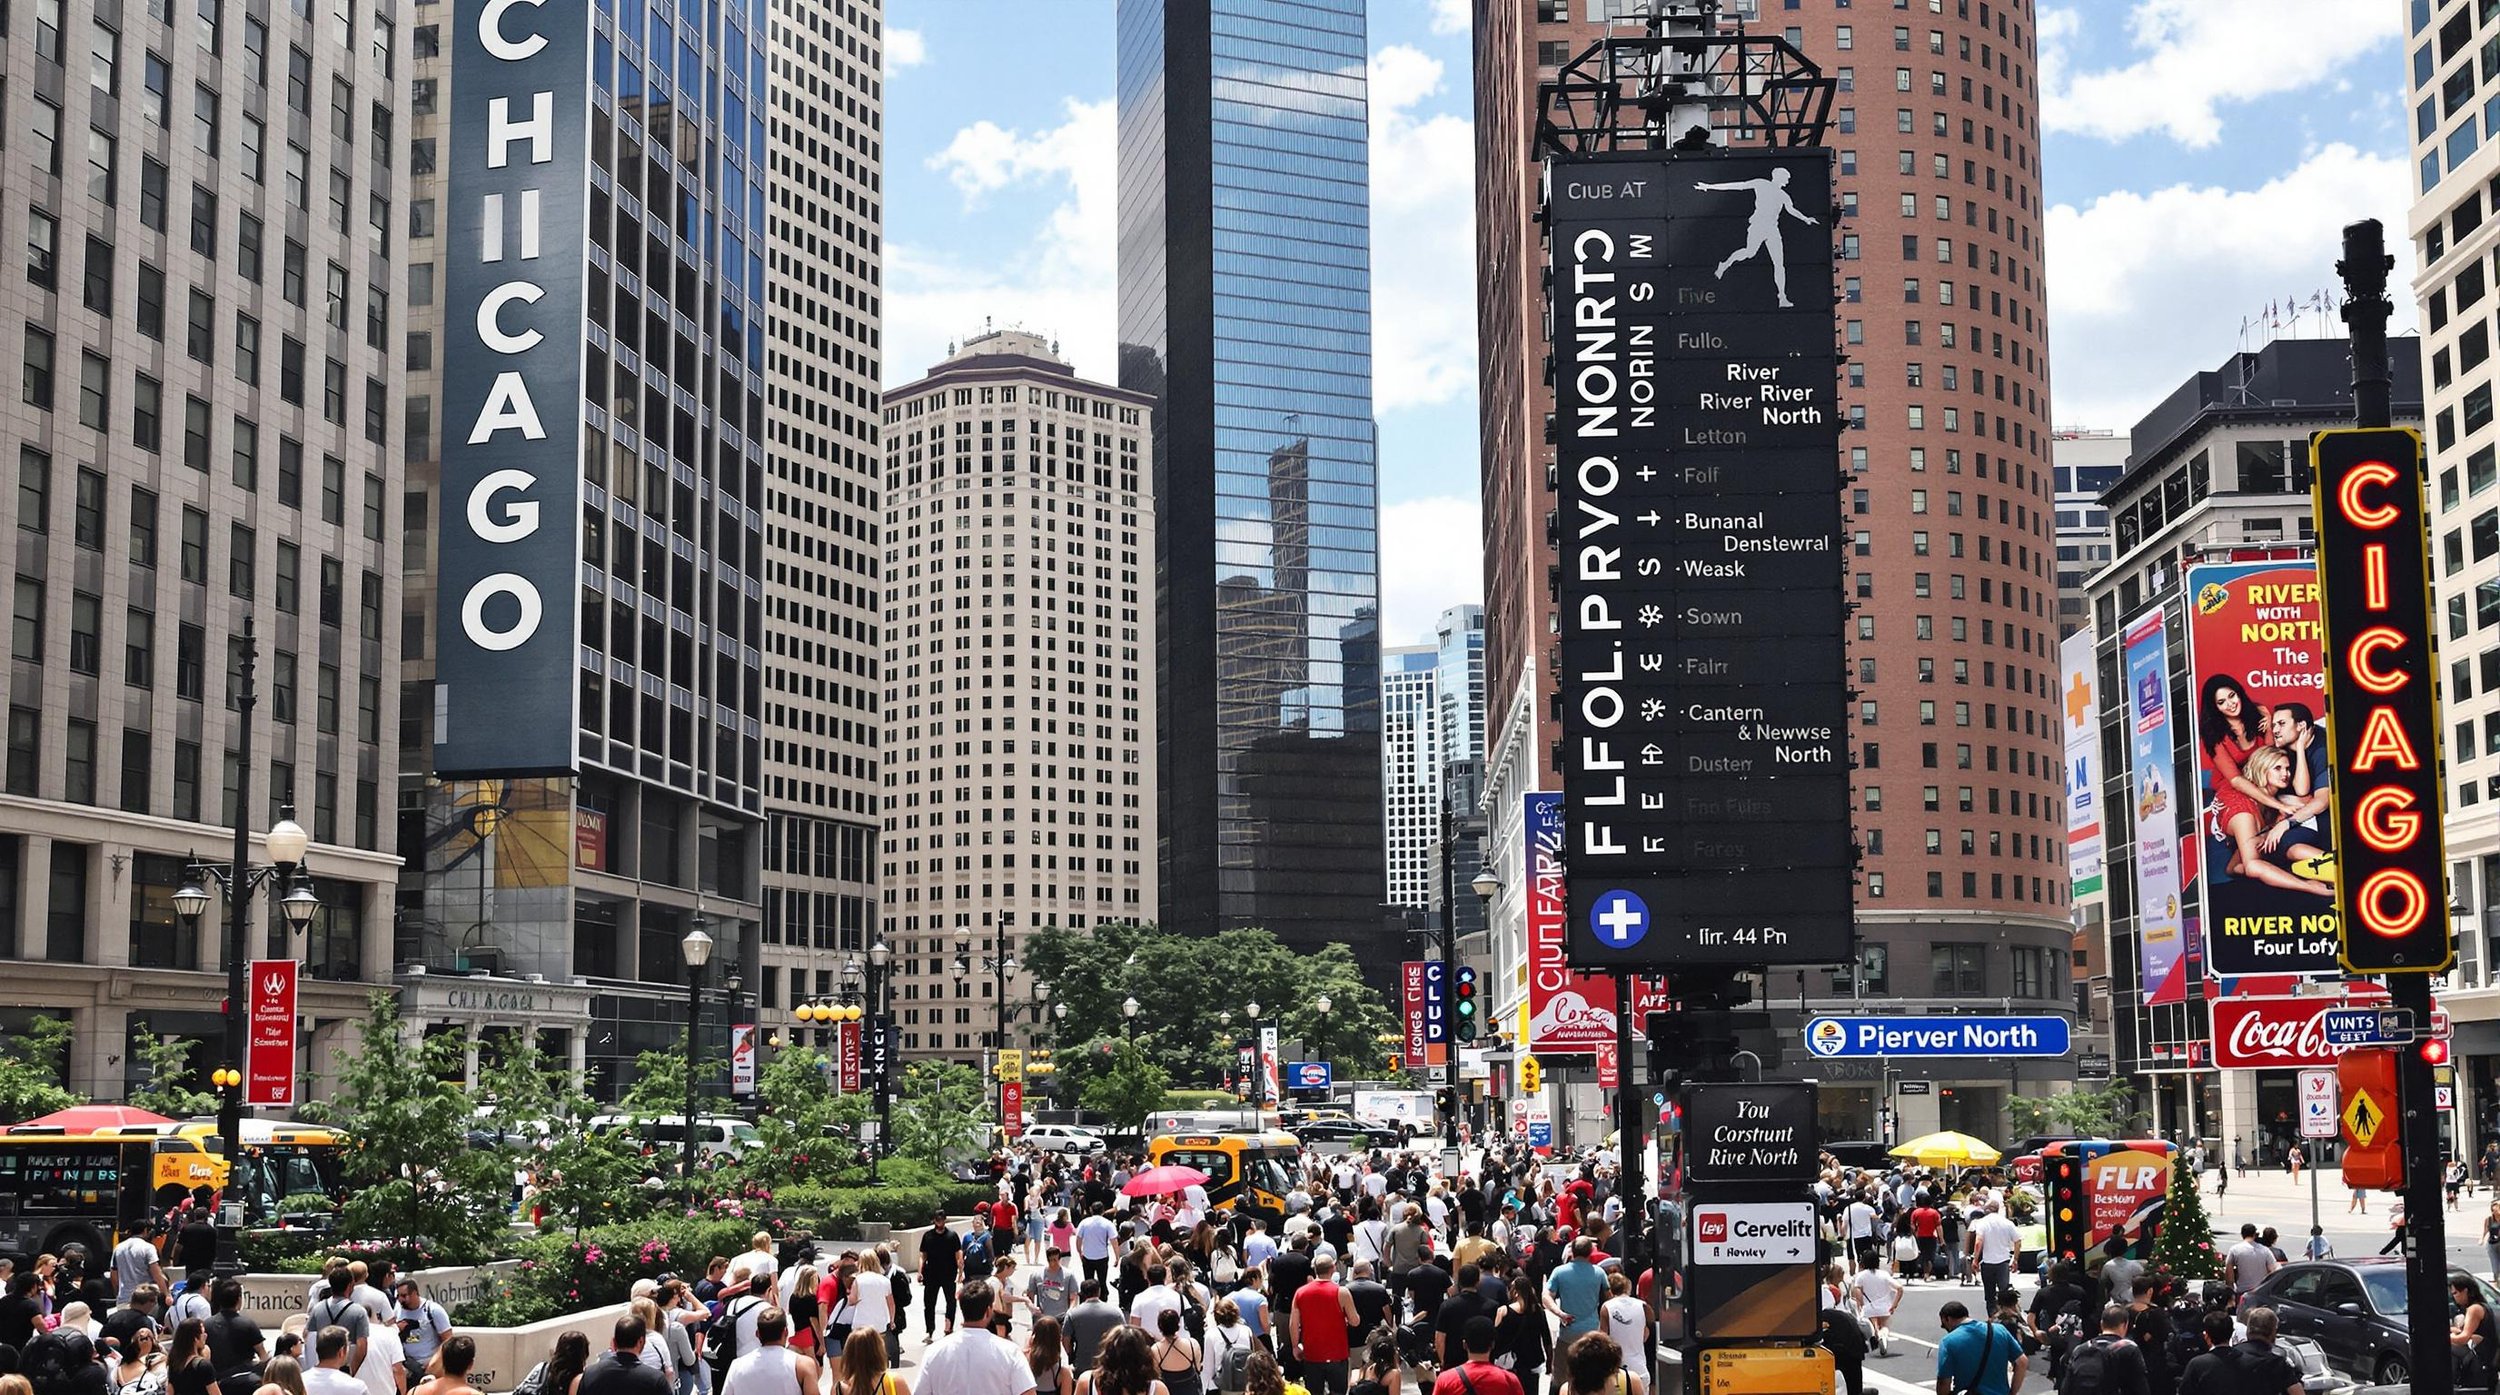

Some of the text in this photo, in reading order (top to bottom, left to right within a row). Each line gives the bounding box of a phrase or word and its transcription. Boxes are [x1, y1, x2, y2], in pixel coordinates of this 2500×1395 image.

[1620, 182, 1647, 198] AT
[1727, 363, 1780, 381] River
[1700, 385, 1813, 410] River River
[1763, 406, 1821, 425] North
[1685, 512, 1764, 529] Bunanal
[1684, 560, 1746, 577] Weask
[2247, 584, 2321, 605] RIVER
[2273, 647, 2310, 664] The
[2337, 461, 2430, 938] CICAGO
[1689, 704, 1764, 720] Cantern
[1738, 724, 1752, 740] &
[1775, 745, 1832, 763] North
[2224, 914, 2338, 936] RIVER NO
[1733, 928, 1757, 944] 44
[2254, 939, 2294, 956] Four
[2329, 1016, 2375, 1030] VINTS
[1858, 1024, 2037, 1048] Pierver North
[1737, 1101, 1770, 1119] You
[1708, 1148, 1798, 1166] Rive North
[2096, 1166, 2158, 1190] FLR
